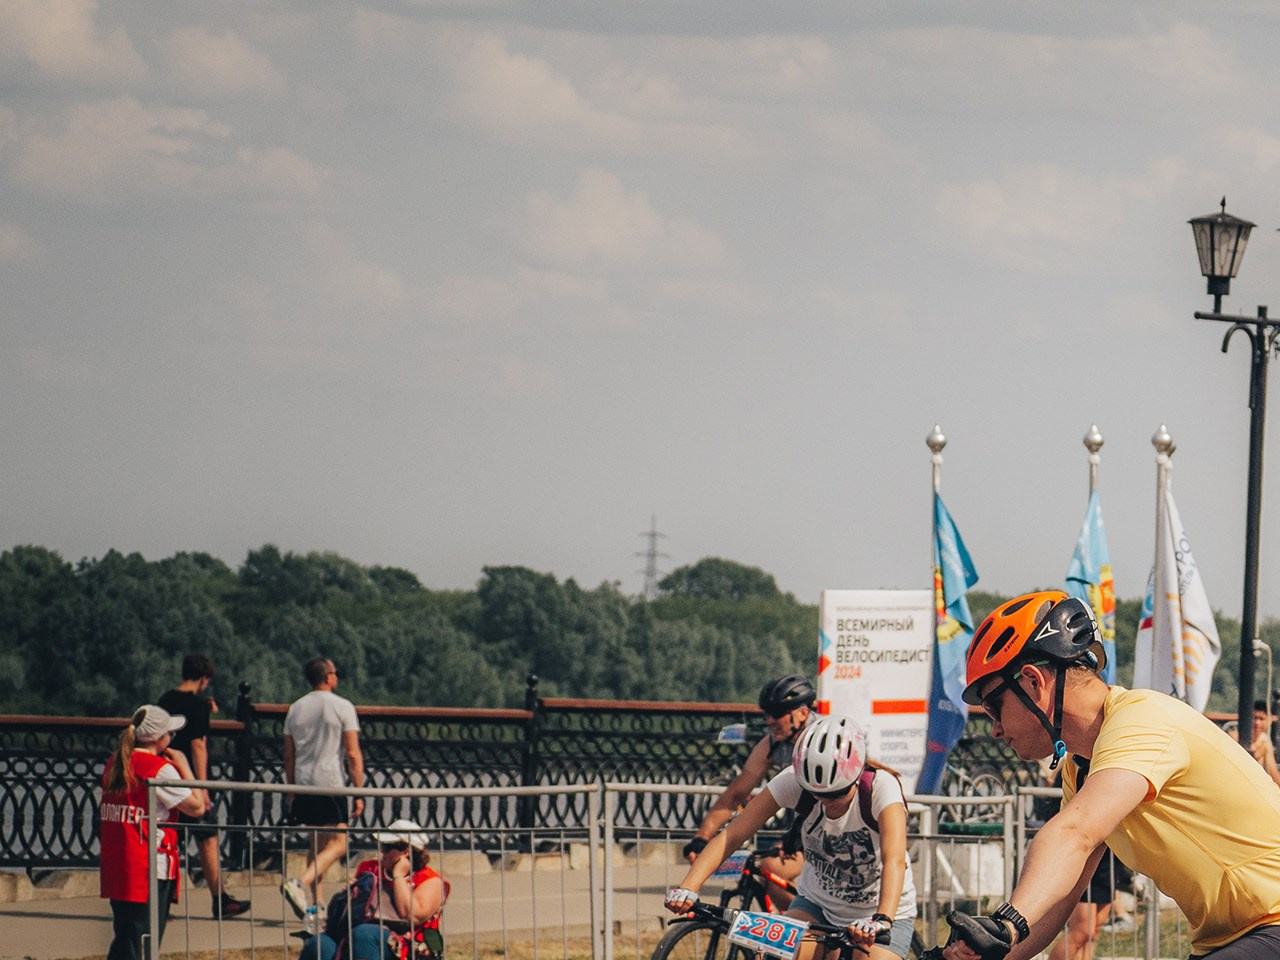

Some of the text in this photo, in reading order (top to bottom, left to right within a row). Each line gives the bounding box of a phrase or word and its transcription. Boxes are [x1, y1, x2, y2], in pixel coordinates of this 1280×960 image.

[837, 615, 914, 631] ВСЕМИРНЫЙ
[836, 634, 870, 648] ДЕНЬ
[837, 649, 931, 664] ВЕЛОСИПЕДИСТ
[834, 665, 862, 679] 2024
[100, 803, 145, 824] ОЛОНТЕР
[749, 917, 799, 948] 281
